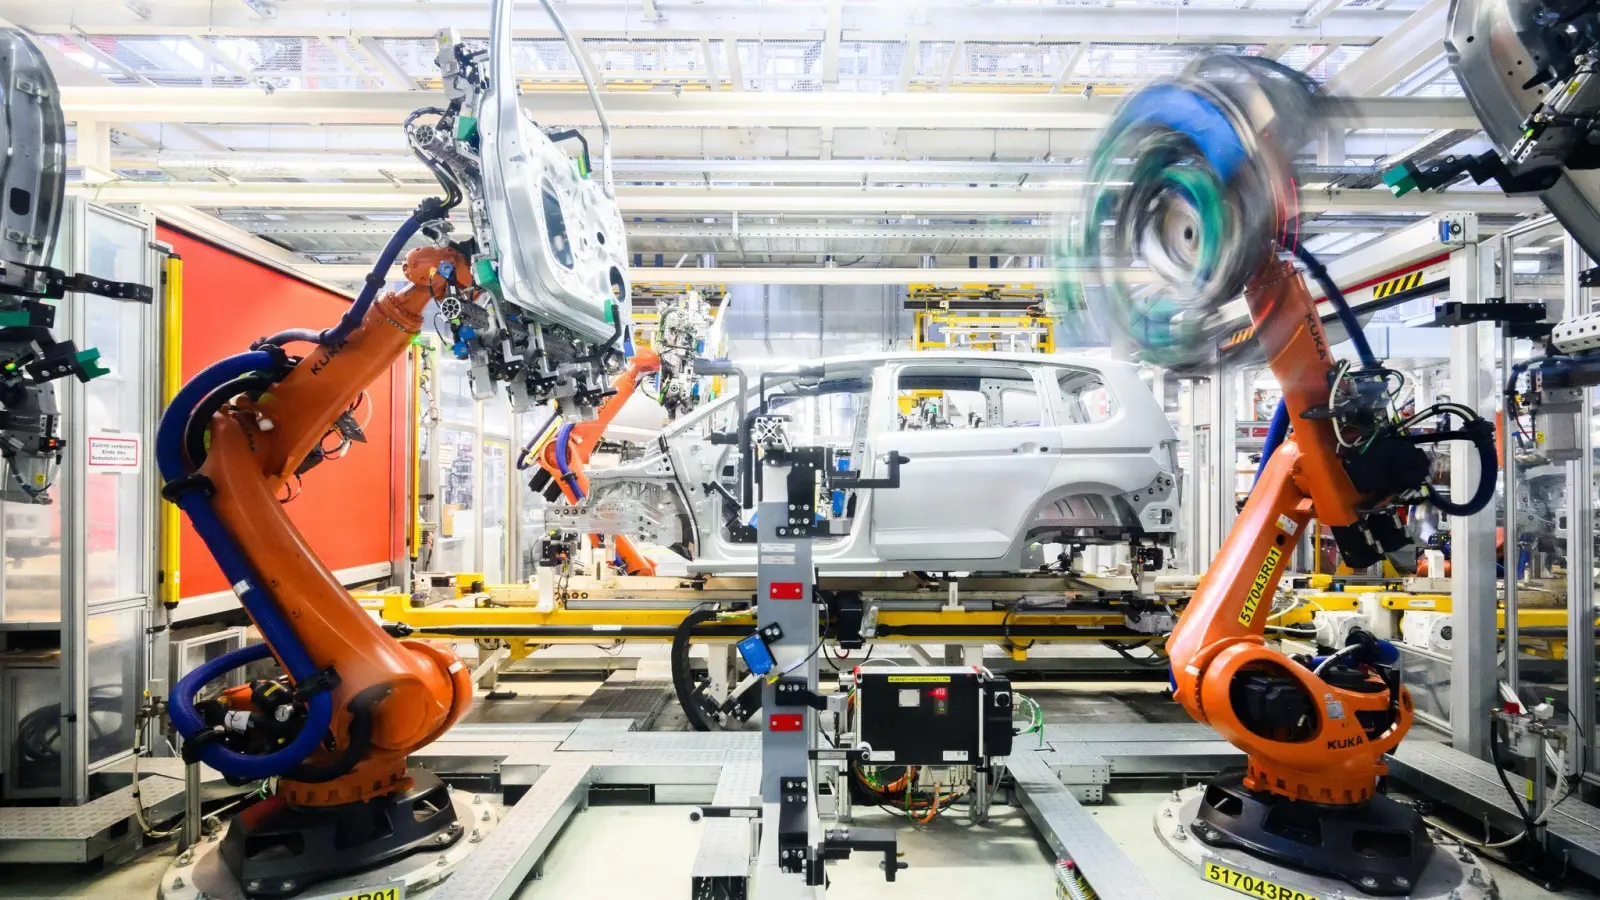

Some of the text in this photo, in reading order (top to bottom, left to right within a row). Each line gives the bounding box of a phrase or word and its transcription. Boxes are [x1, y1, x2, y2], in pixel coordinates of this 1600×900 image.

[1305, 313, 1326, 360] KUKA
[310, 339, 349, 376] KUA
[1240, 548, 1281, 623] 517043R01
[1327, 735, 1363, 750] KUKA
[1210, 865, 1317, 900] 517043R
